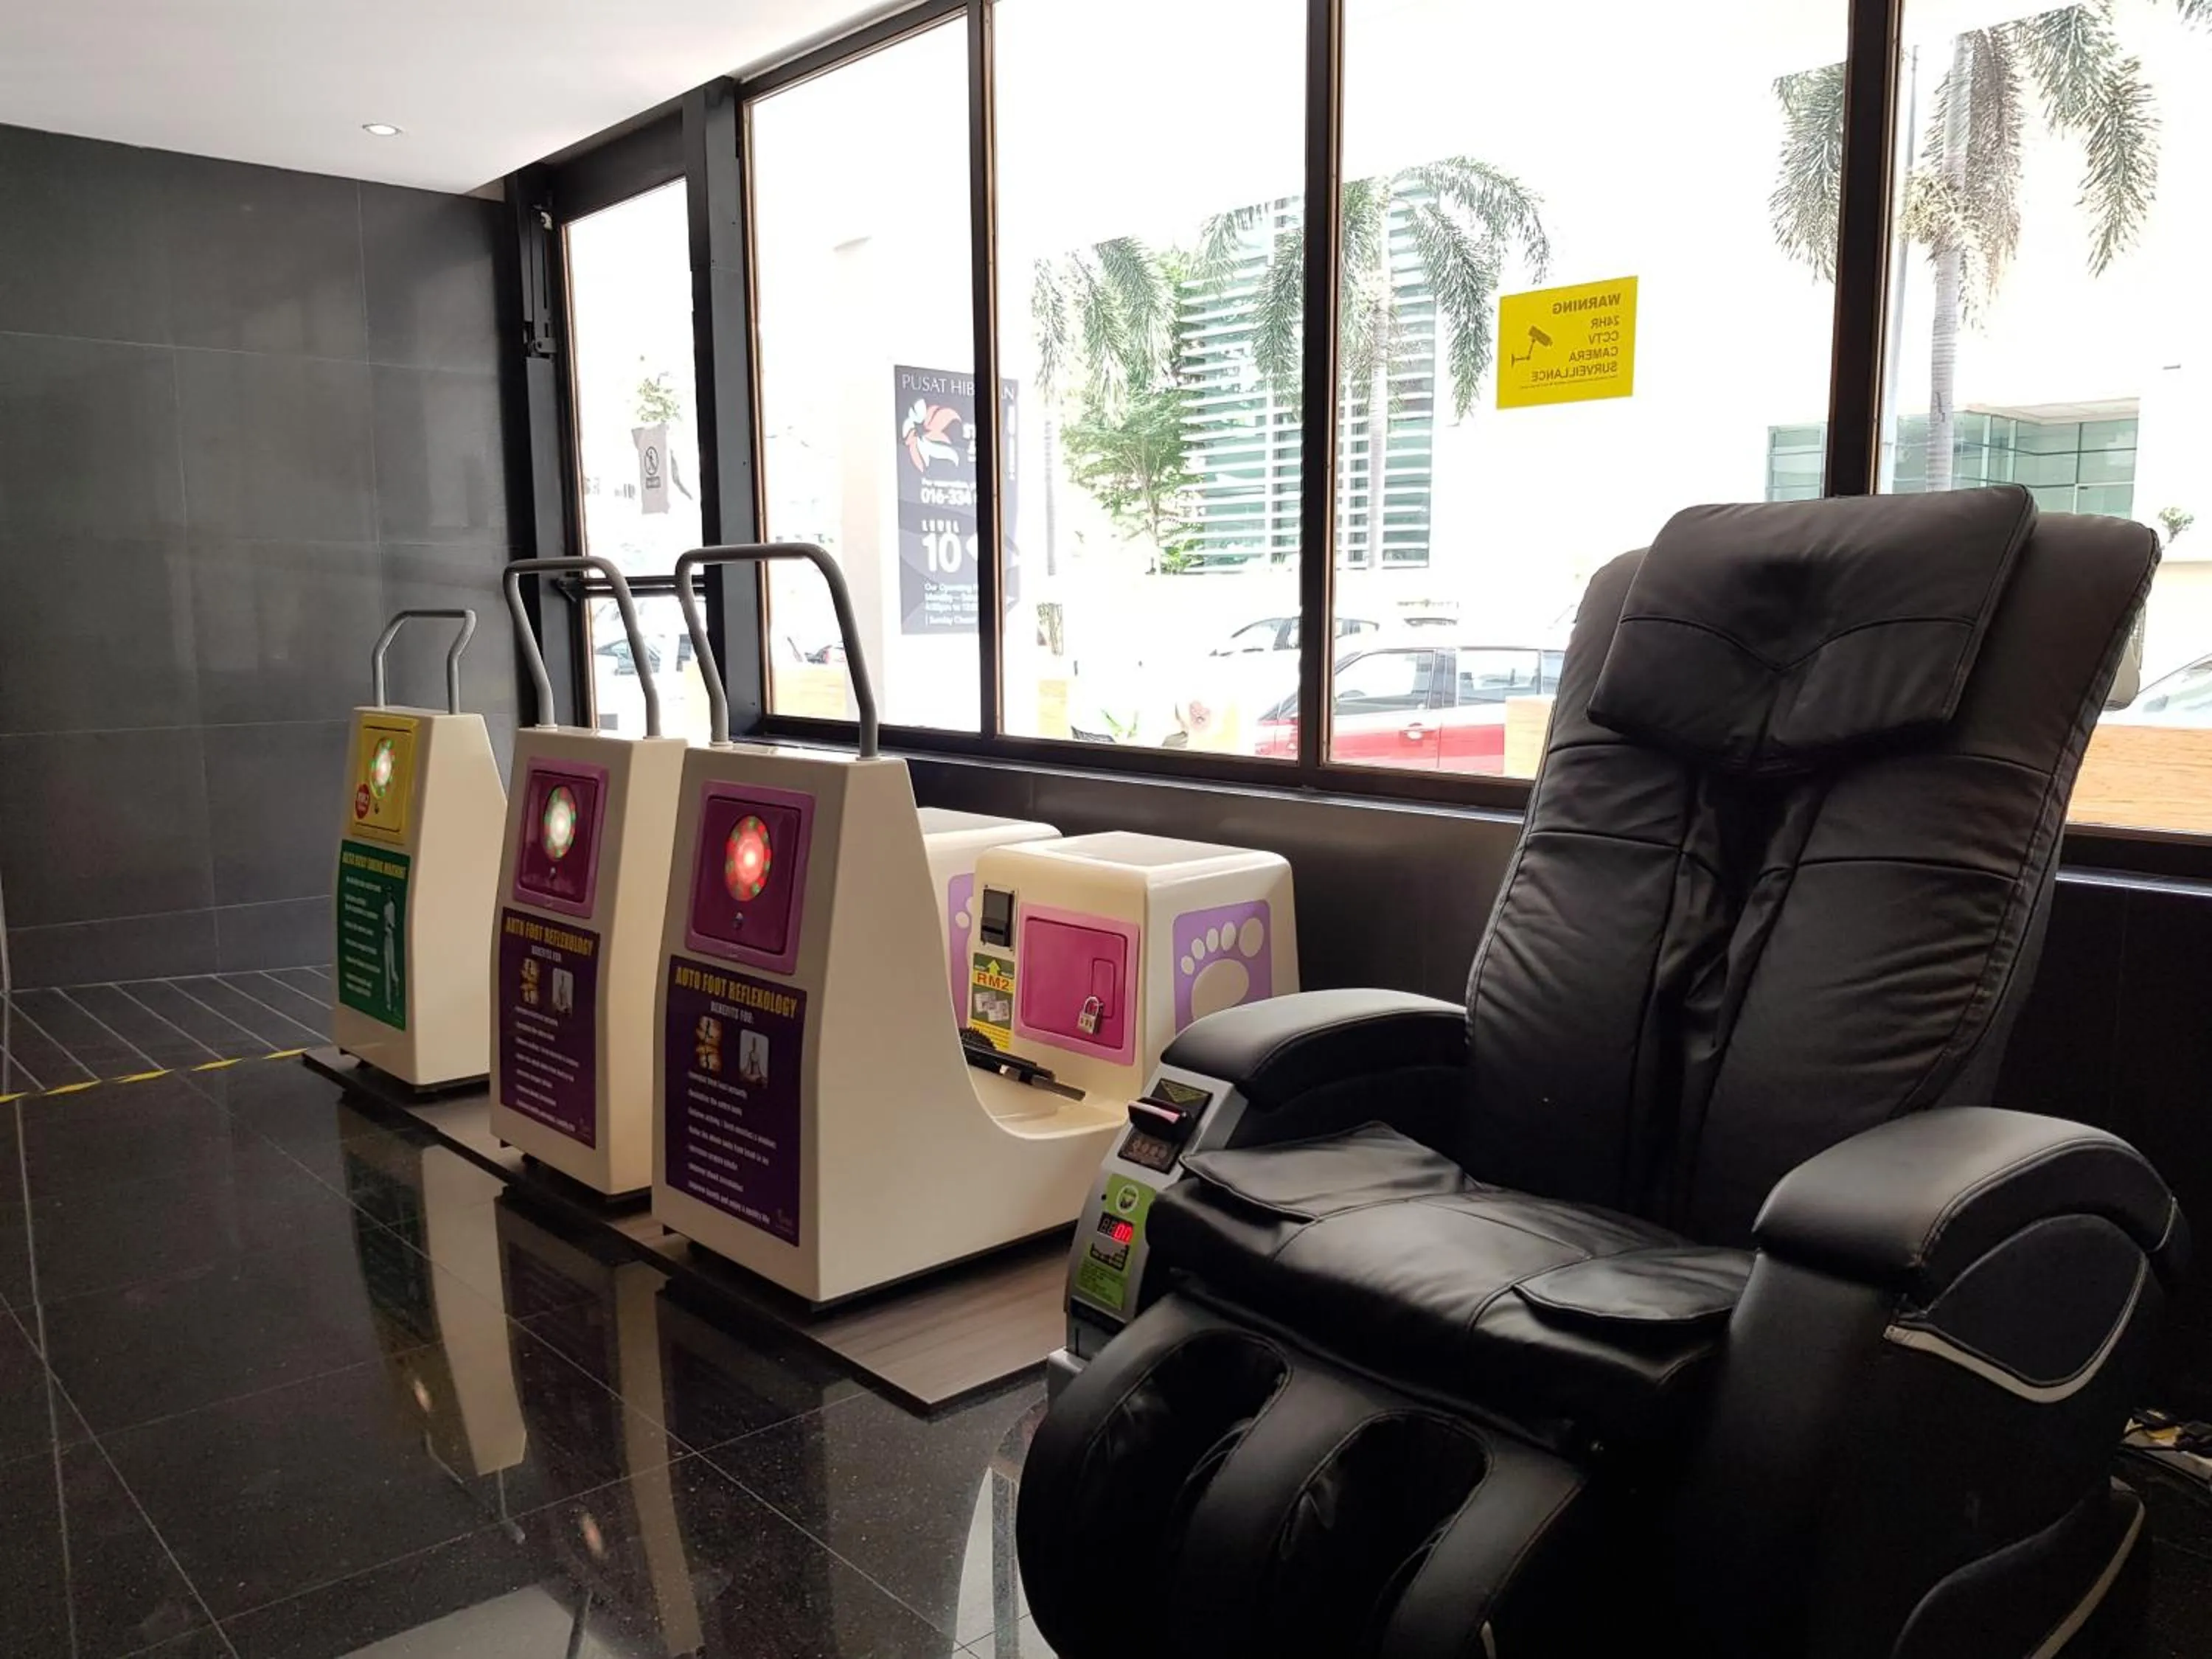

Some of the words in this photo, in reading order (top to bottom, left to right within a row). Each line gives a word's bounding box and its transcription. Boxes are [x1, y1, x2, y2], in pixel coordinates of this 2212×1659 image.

[902, 373, 947, 394] PUSAT
[922, 532, 962, 574] 10
[675, 965, 700, 990] AUTO
[701, 973, 727, 998] FOOT
[728, 981, 798, 1019] REFLEXOLOGY
[977, 973, 1009, 991] RM2
